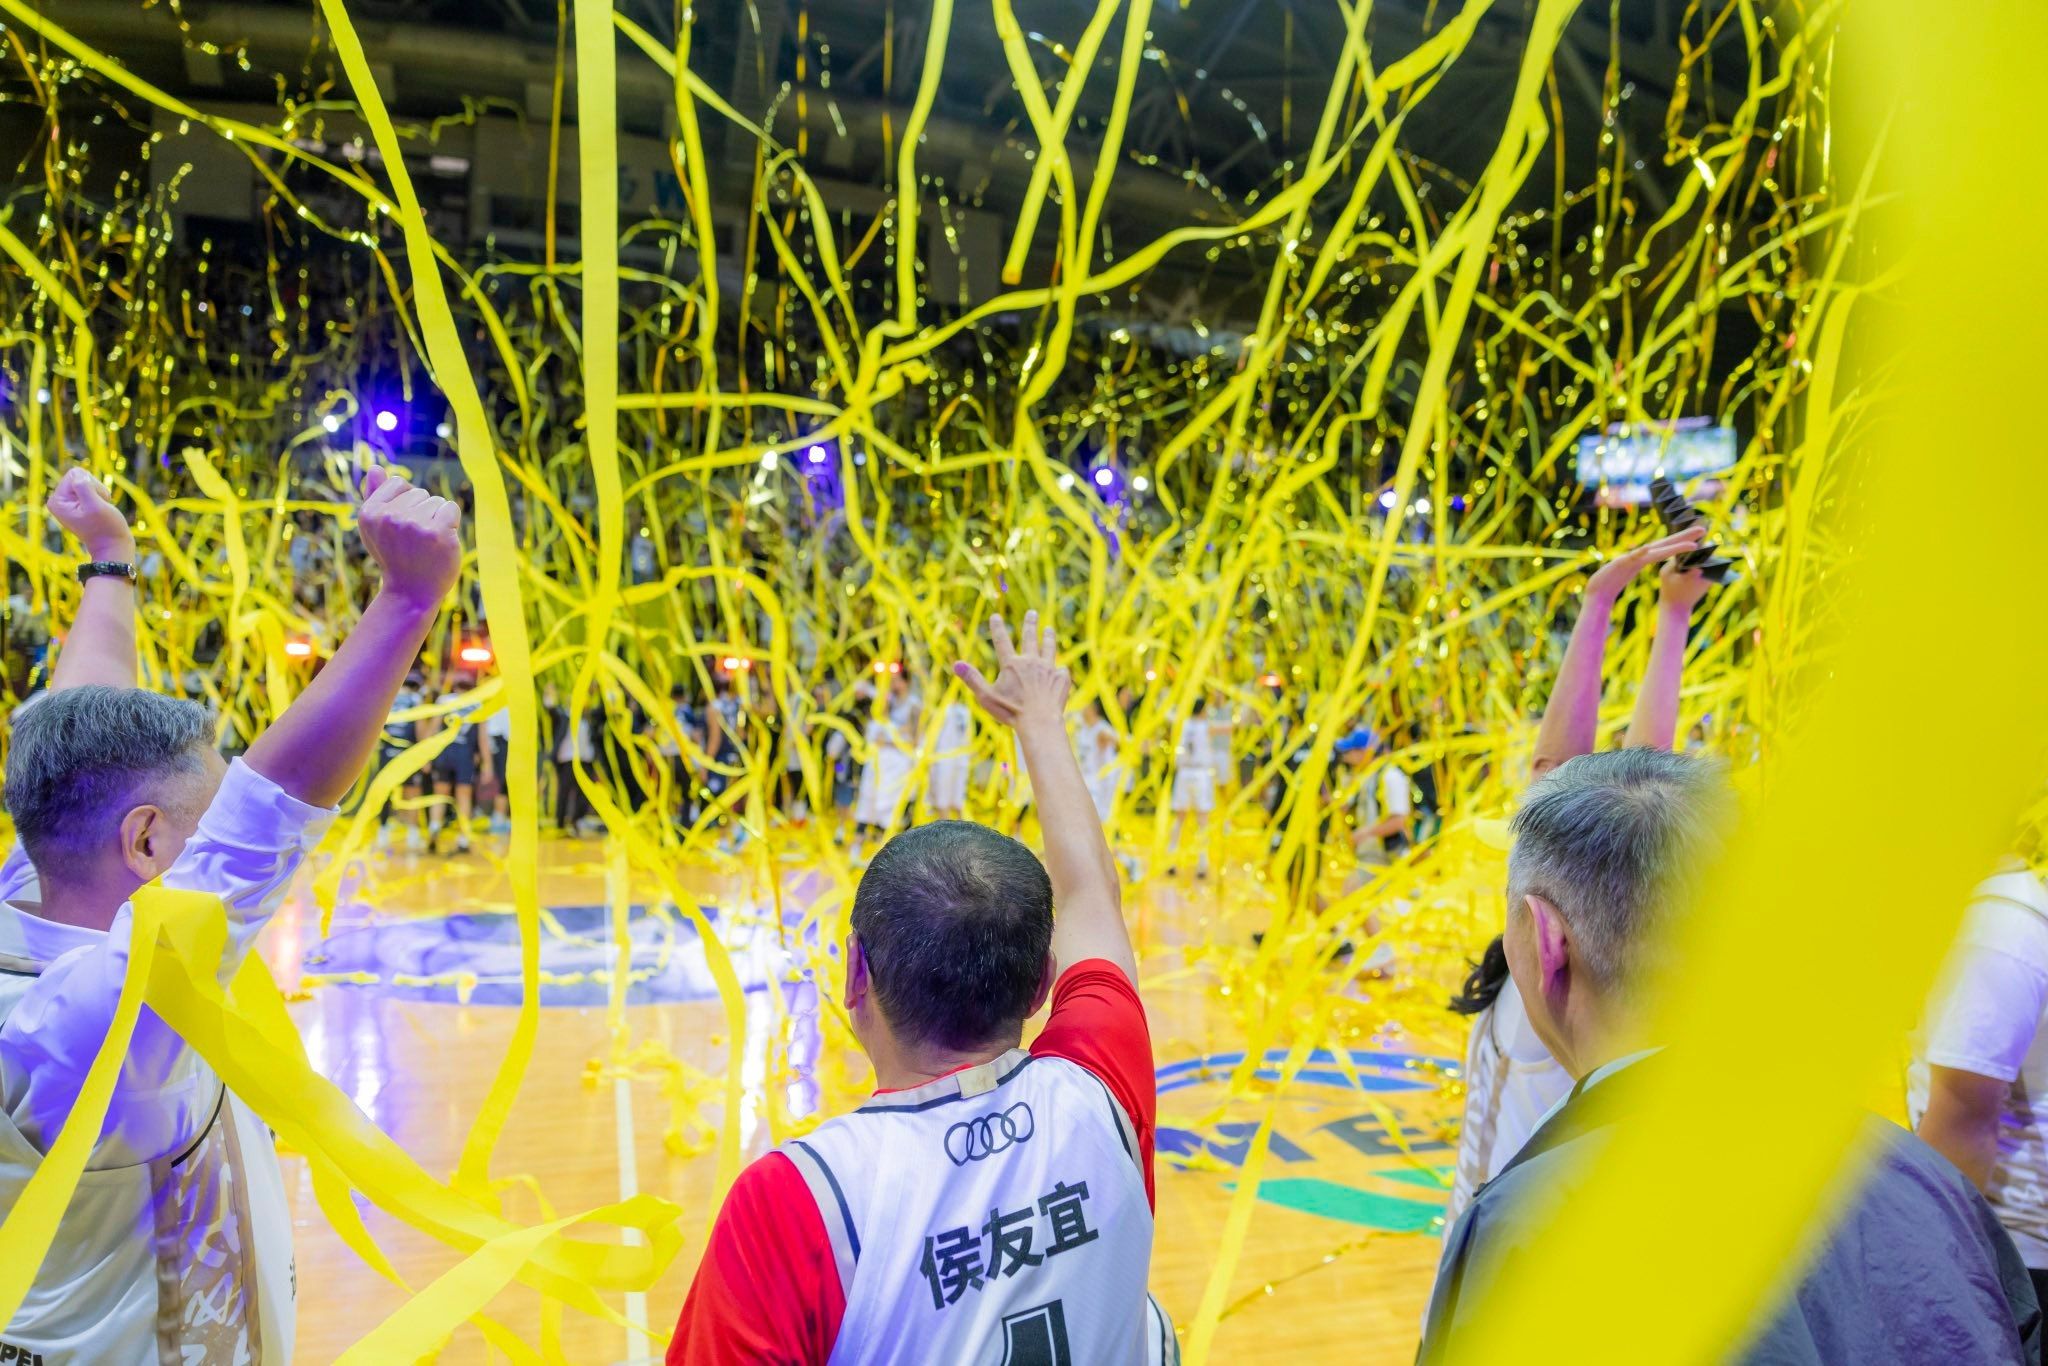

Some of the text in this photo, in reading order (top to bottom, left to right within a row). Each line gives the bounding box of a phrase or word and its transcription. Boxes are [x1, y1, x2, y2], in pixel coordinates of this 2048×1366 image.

[919, 1180, 1099, 1311] 侯友宜
[0, 1341, 43, 1366] PEI
